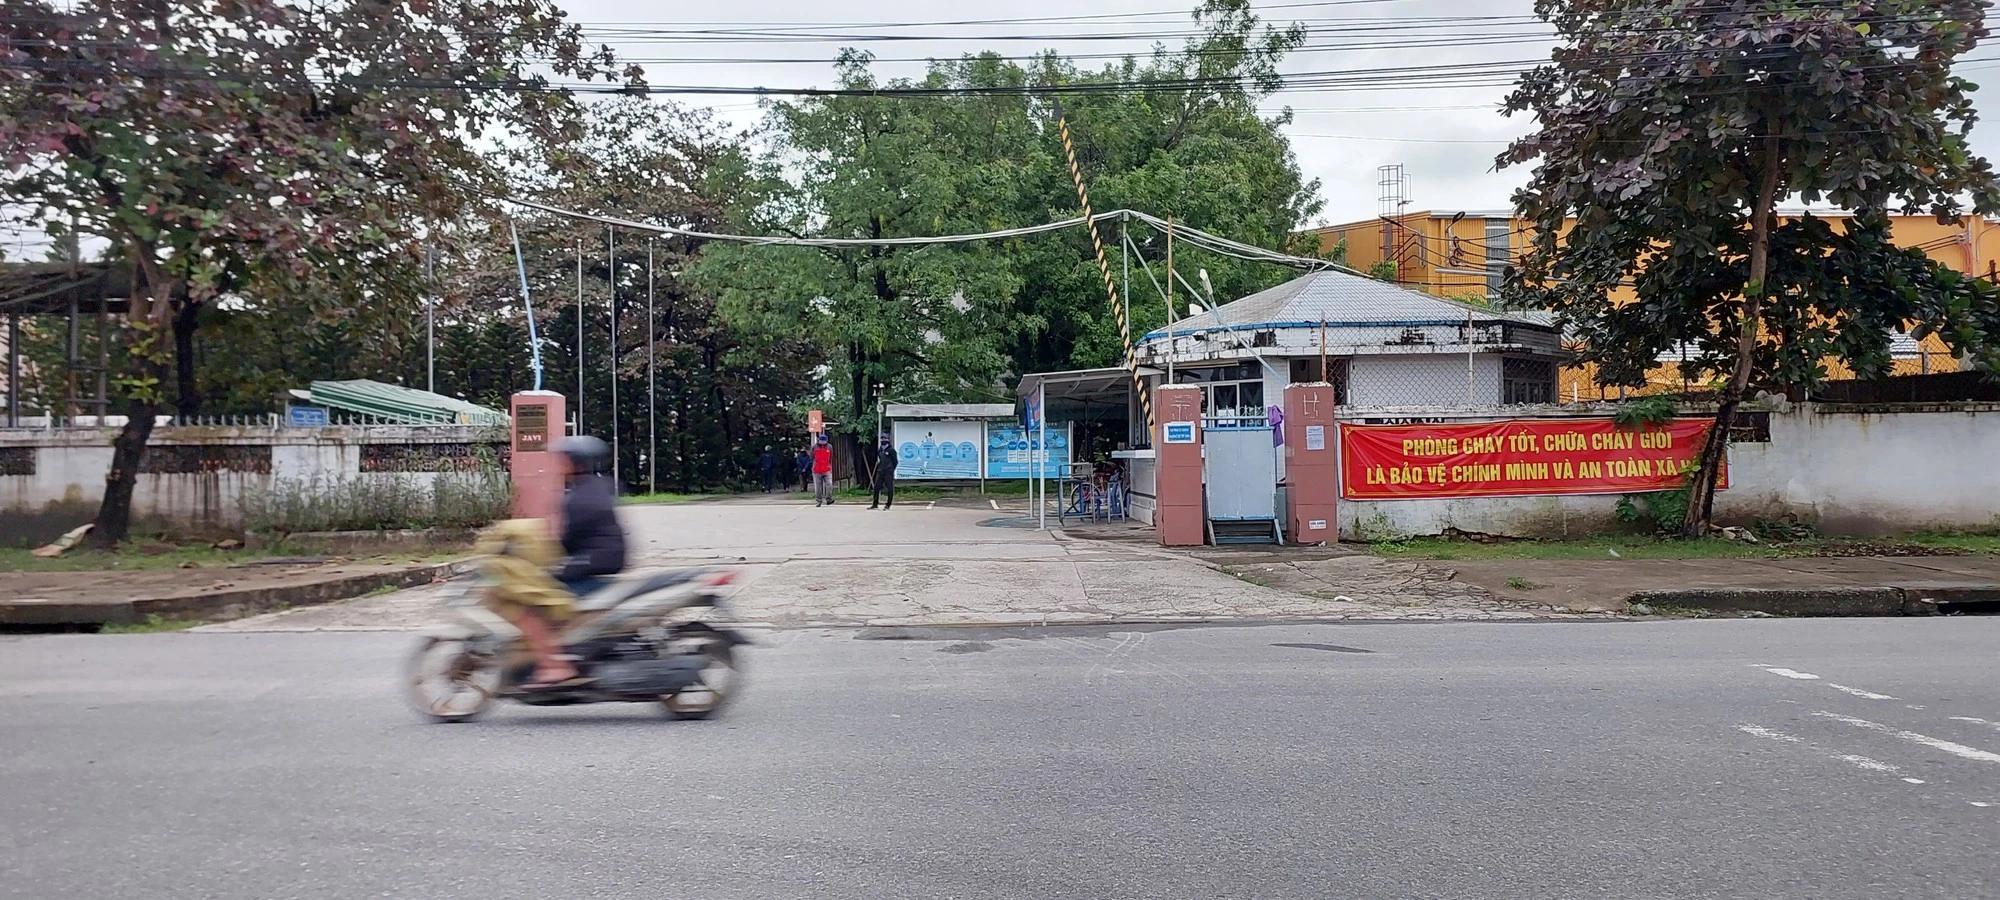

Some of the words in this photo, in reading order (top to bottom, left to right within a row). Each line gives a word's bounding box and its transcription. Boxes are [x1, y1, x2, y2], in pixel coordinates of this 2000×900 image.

[904, 444, 972, 459] STEP
[1403, 435, 1458, 456] PHÒNG
[1462, 433, 1504, 455] CHÁY
[1508, 429, 1540, 454] TỐT,
[1544, 430, 1587, 451] CHỮA
[1591, 429, 1634, 450] CHÁY
[1639, 427, 1672, 449] GIỎI
[1366, 464, 1386, 485] LÀ
[1390, 462, 1422, 485] BẢO
[1427, 462, 1447, 487] VỆ
[1451, 461, 1501, 483] CHÍNH
[1505, 459, 1549, 481] MÌNH
[1552, 458, 1574, 479] VÀ
[1578, 461, 1602, 479] AN
[1605, 457, 1652, 478] TOÀN
[1655, 457, 1678, 476] XÃ
